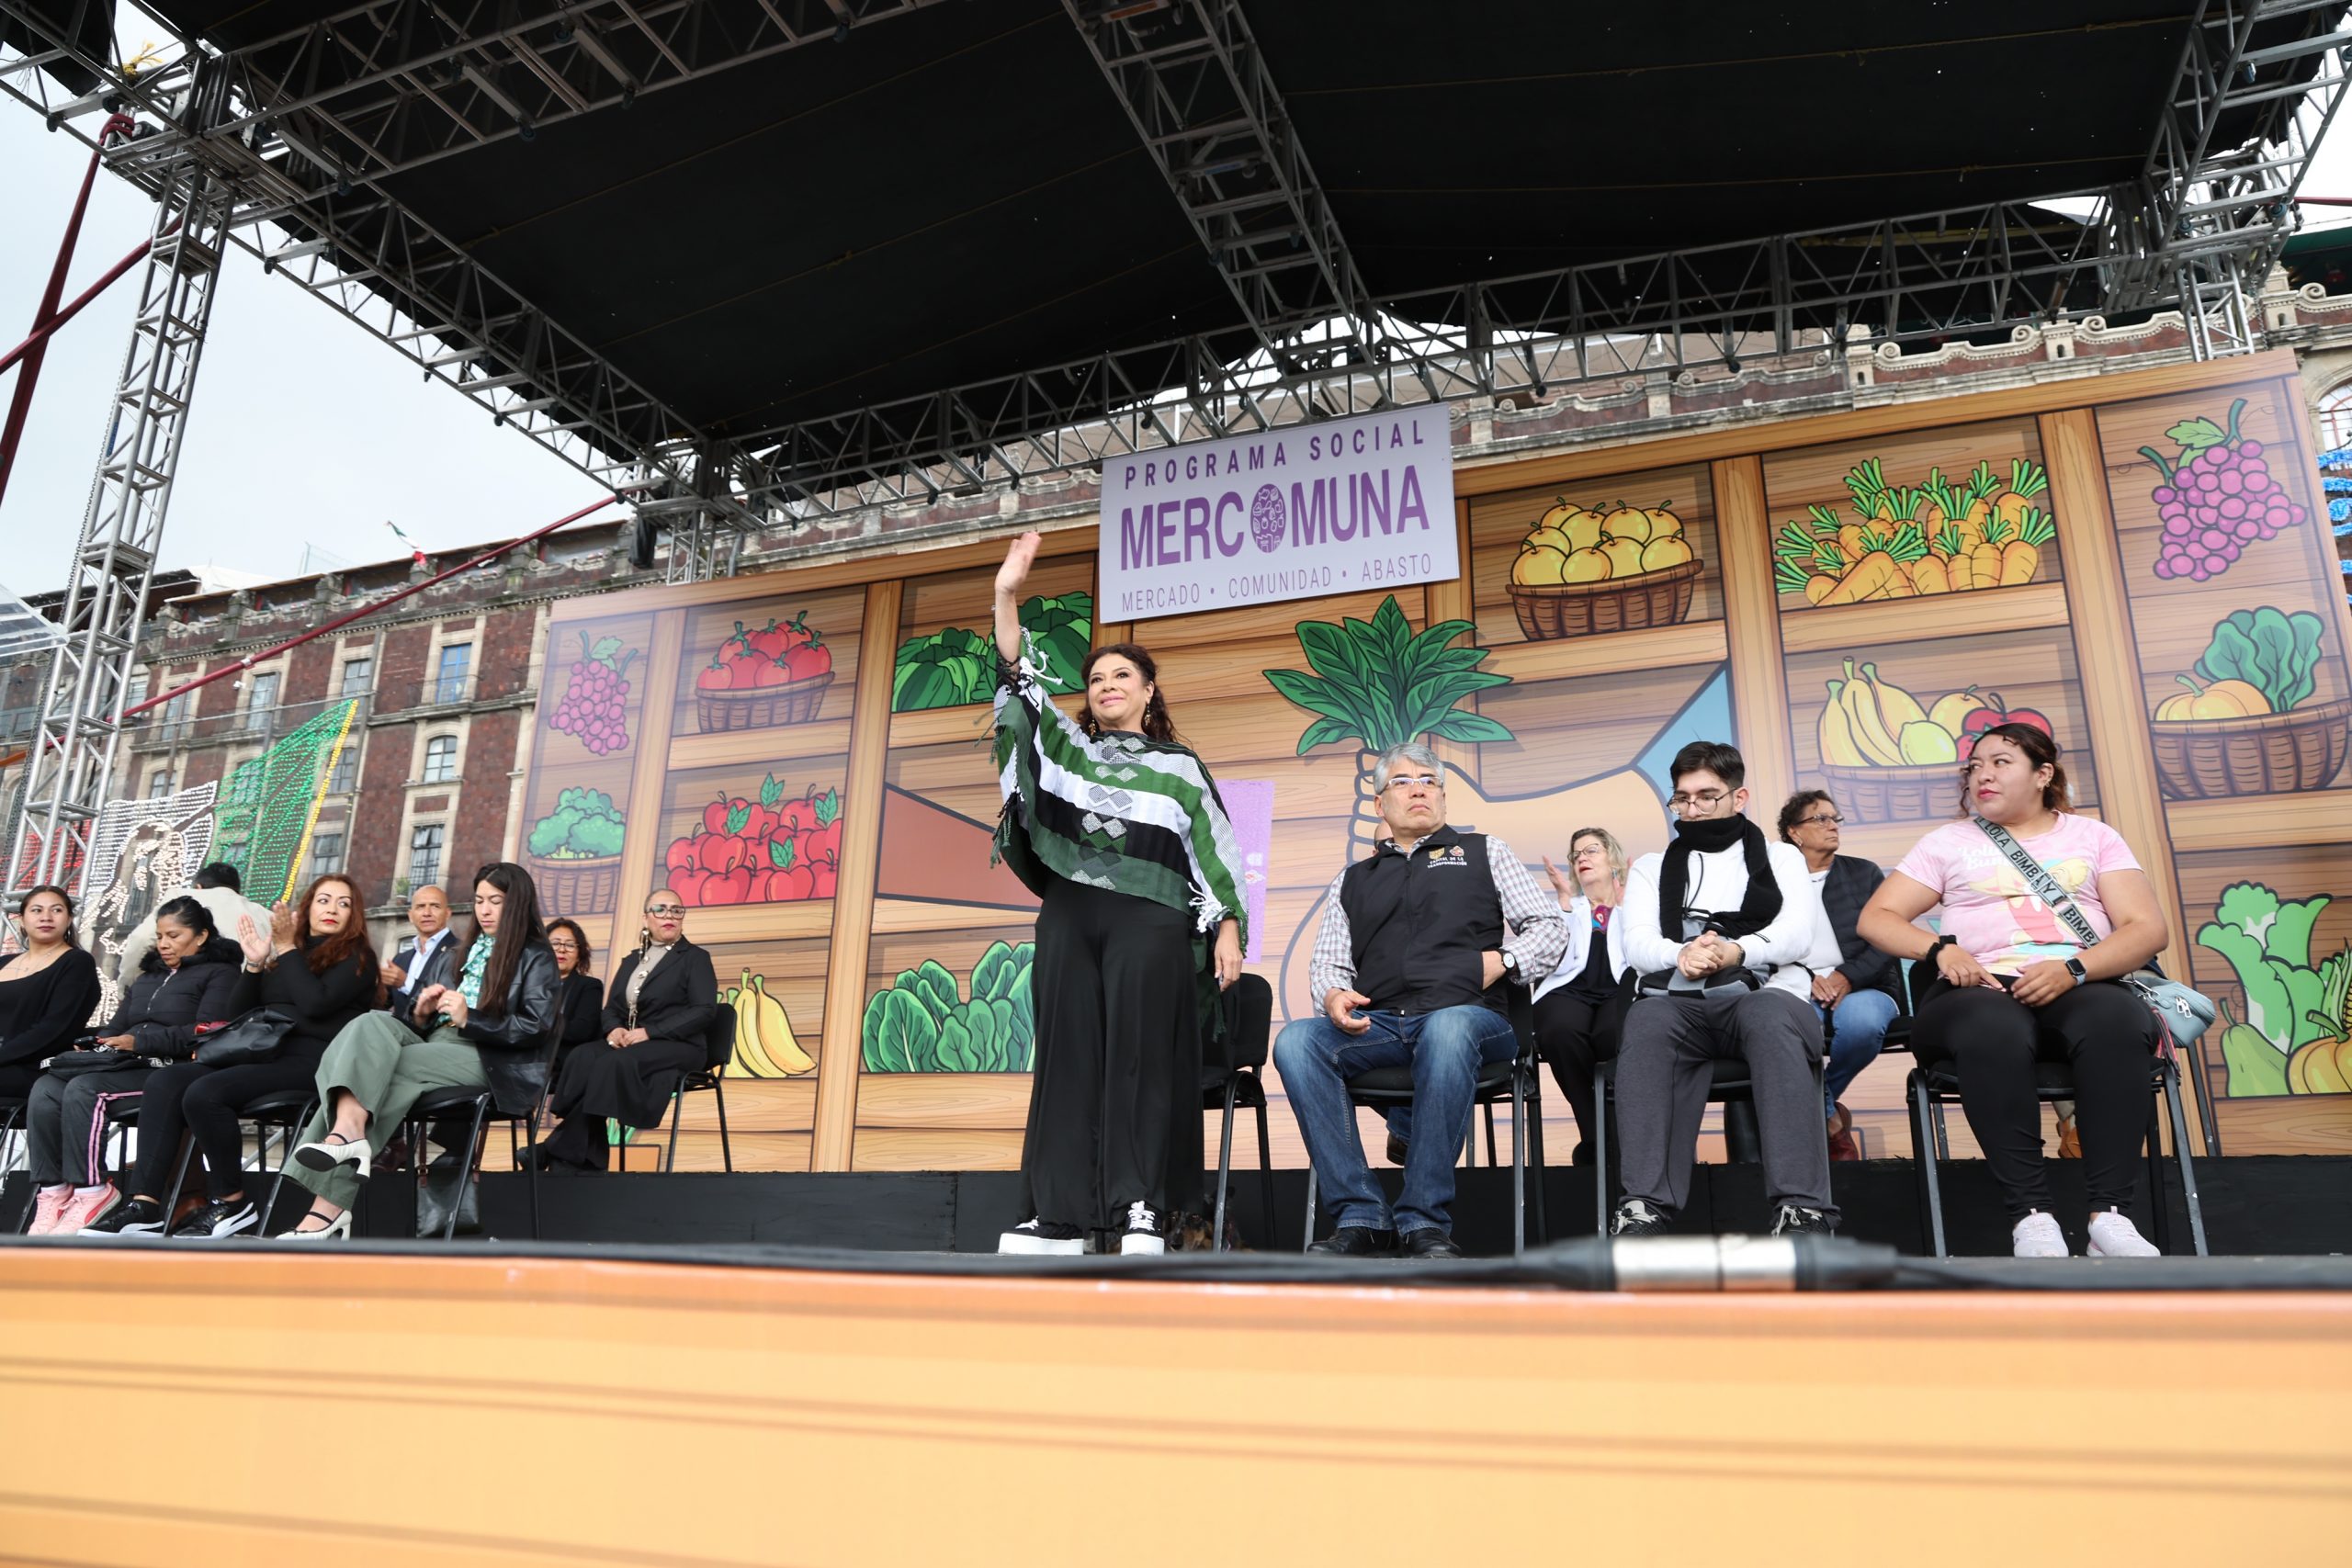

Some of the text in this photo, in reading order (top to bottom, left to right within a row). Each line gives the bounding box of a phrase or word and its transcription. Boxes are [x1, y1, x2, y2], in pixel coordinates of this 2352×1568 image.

[1125, 420, 1423, 490] PROGRAMA SOCIAL
[1120, 465, 1430, 570] MERCOMUNA
[1122, 553, 1431, 613] MERCADO COMUNIDAD ABASTO
[1984, 822, 2010, 847] LOLA
[2042, 883, 2056, 893] Y
